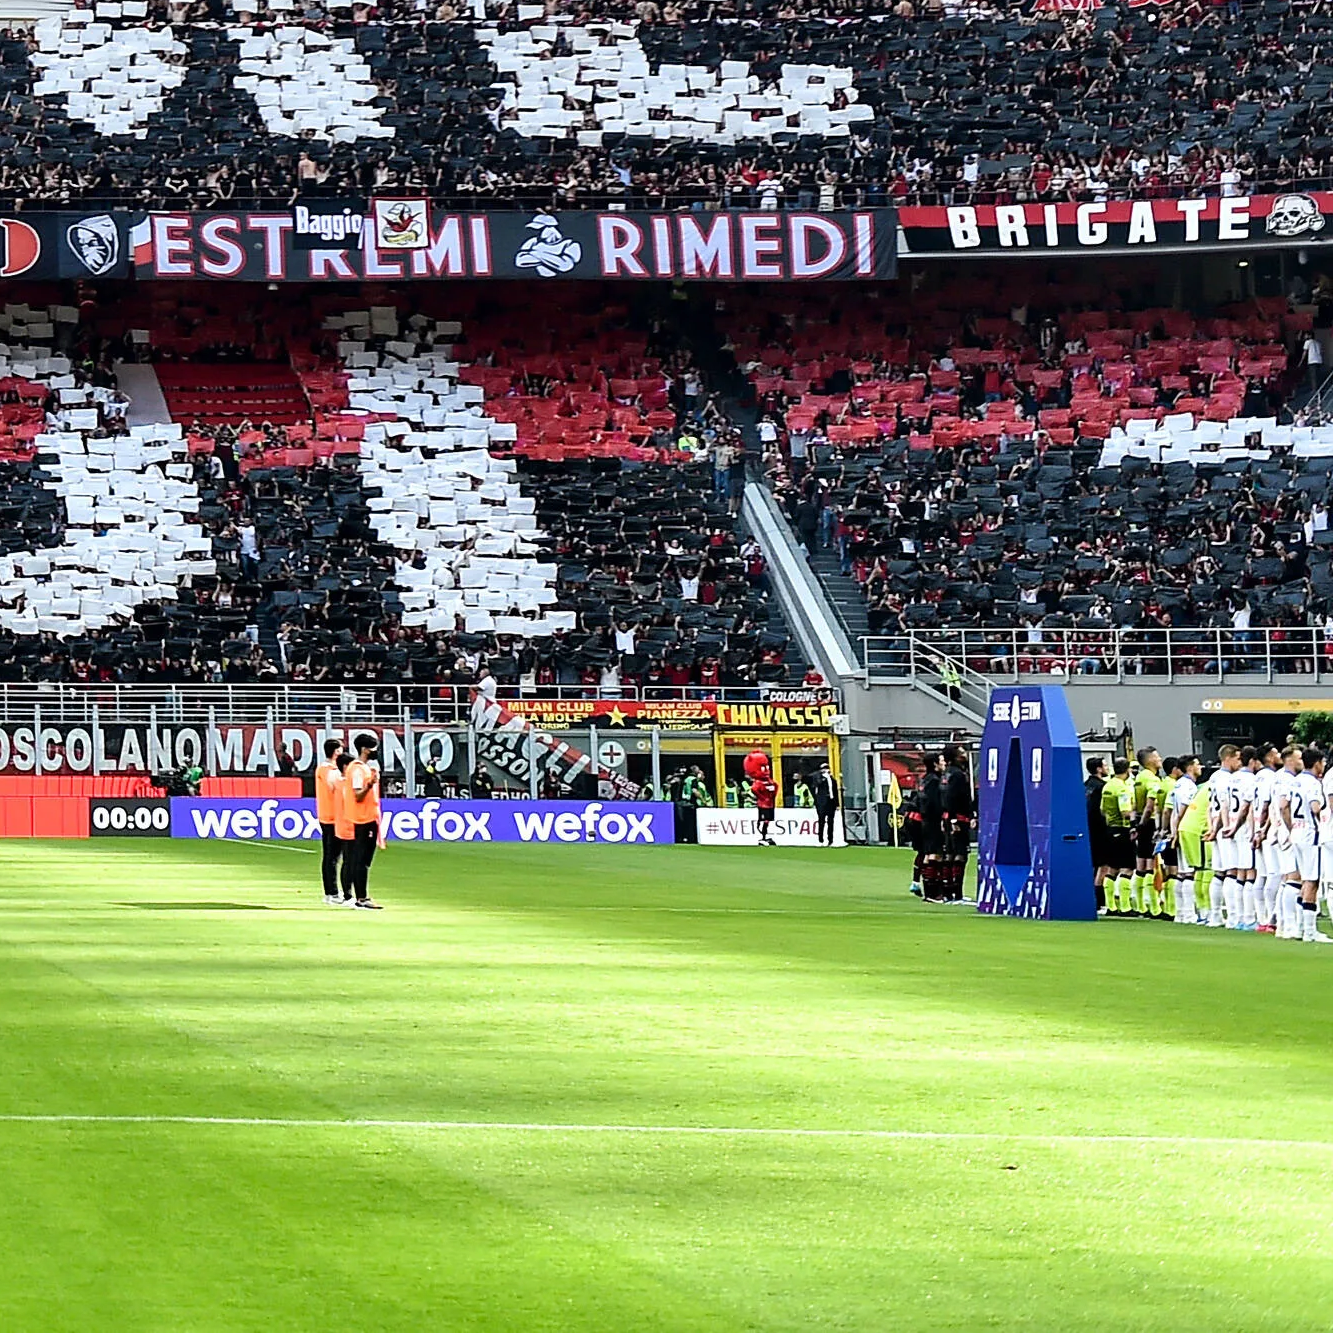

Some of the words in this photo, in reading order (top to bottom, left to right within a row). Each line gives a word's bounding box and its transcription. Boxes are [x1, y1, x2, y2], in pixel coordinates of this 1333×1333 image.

[295, 205, 363, 241] Baggio
[946, 195, 1251, 249] BRIGATE
[151, 215, 490, 279] ESTREMI
[507, 702, 552, 712] MILAN
[556, 702, 594, 712] CLUB
[770, 690, 817, 703] COLOGNE
[637, 709, 711, 719] PIANEZZA
[717, 703, 837, 727] CHIVASSO
[92, 807, 169, 830] 00:00
[191, 800, 323, 839] wefox
[513, 802, 654, 842] wefox
